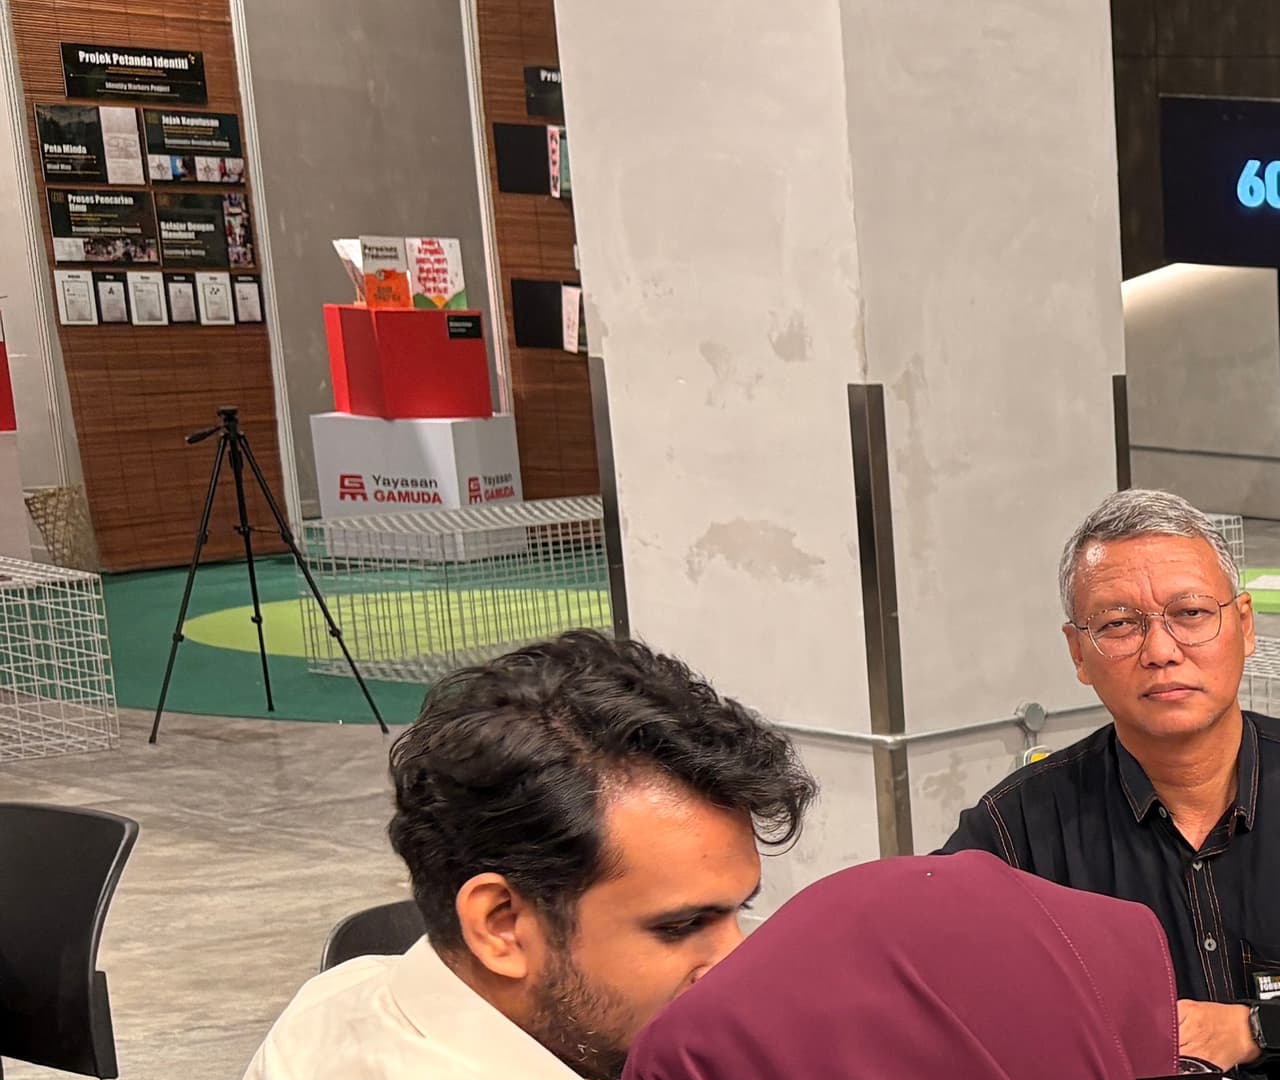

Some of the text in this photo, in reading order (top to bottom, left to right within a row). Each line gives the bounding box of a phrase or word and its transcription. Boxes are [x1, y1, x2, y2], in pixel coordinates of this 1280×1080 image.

[78, 50, 189, 70] Projek Petanda Identiti
[44, 143, 87, 154] Peta Minda
[68, 193, 95, 204] Proses
[372, 474, 438, 490] Yayasan
[482, 472, 513, 487] Yayasan
[373, 490, 443, 504] GAMUDA
[484, 486, 515, 500] GAMUDA
